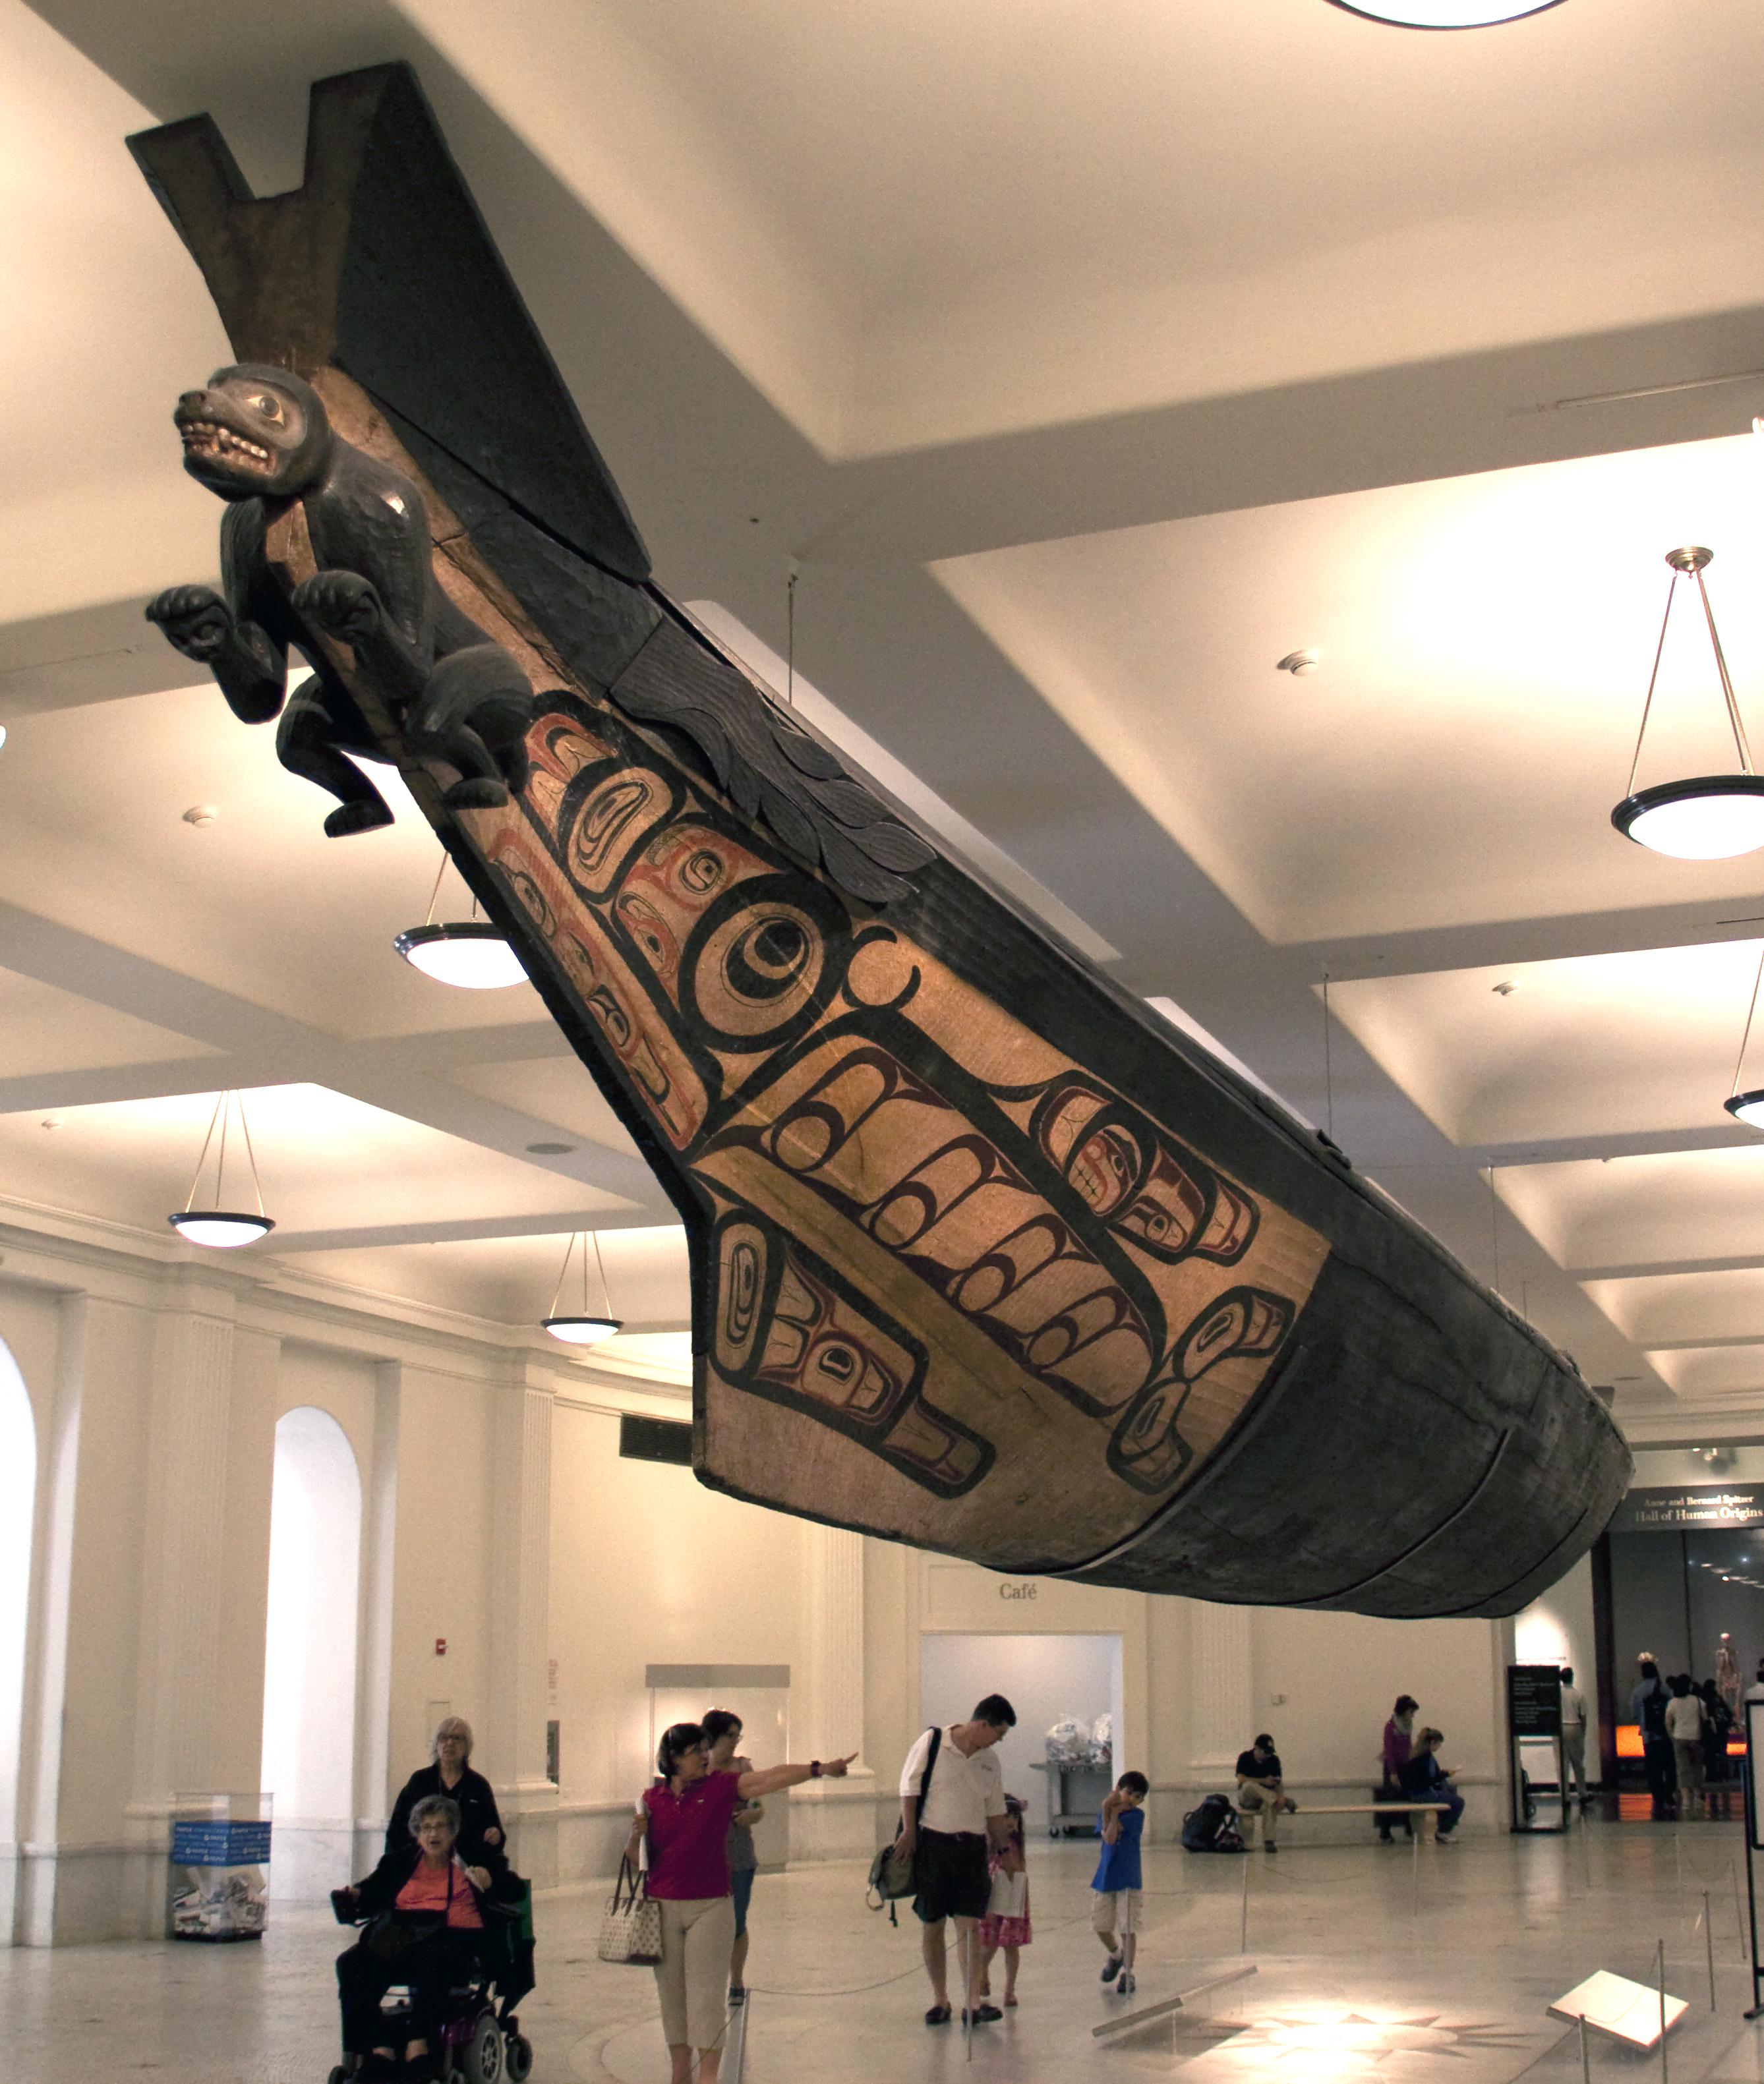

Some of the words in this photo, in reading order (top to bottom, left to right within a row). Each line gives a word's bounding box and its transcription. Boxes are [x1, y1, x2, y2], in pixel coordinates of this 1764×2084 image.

[1668, 1497, 1684, 1506] and
[1686, 1495, 1721, 1505] Bernard
[1635, 1510, 1661, 1522] Hall
[1661, 1509, 1674, 1520] of
[1676, 1508, 1718, 1520] Human
[1719, 1507, 1763, 1521] Origins
[999, 1582, 1037, 1600] Café
